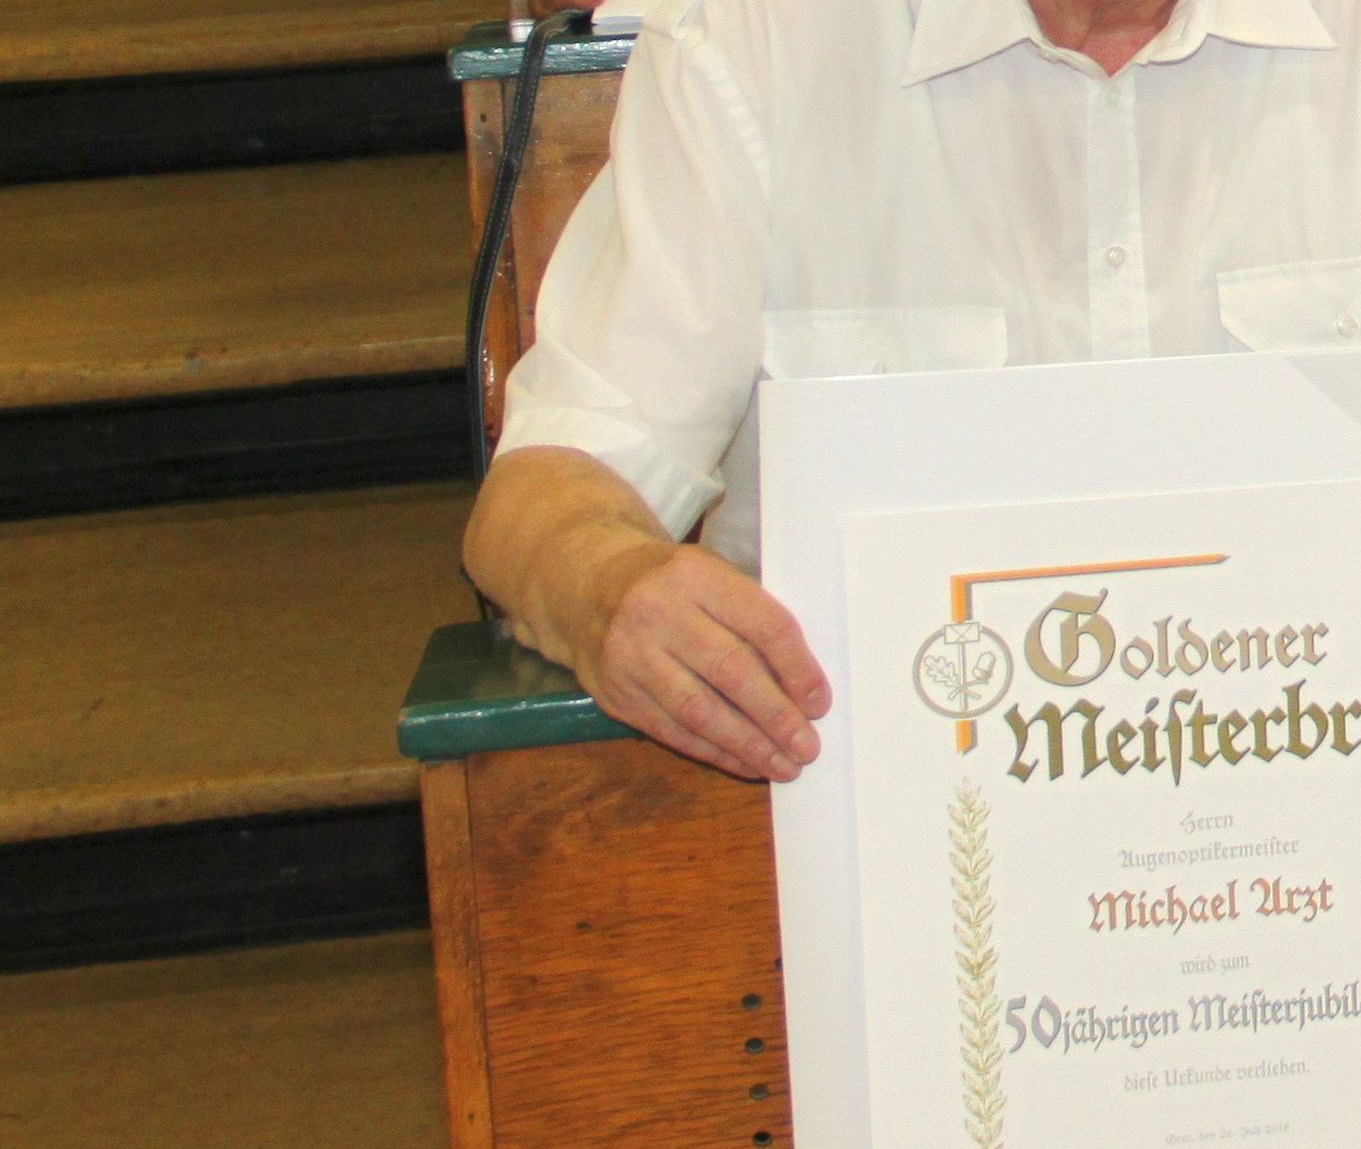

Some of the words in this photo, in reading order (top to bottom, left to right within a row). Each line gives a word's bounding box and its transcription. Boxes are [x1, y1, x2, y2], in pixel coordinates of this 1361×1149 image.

[1023, 588, 1329, 687] Goldener
[1180, 811, 1233, 834] Herrn
[1088, 878, 1240, 936] Michael
[1249, 875, 1334, 923] Arzt
[1180, 955, 1216, 975] wird
[1220, 954, 1250, 974] zum
[1005, 992, 1180, 1052] 50jährigen
[1163, 1065, 1232, 1088] Urkunde
